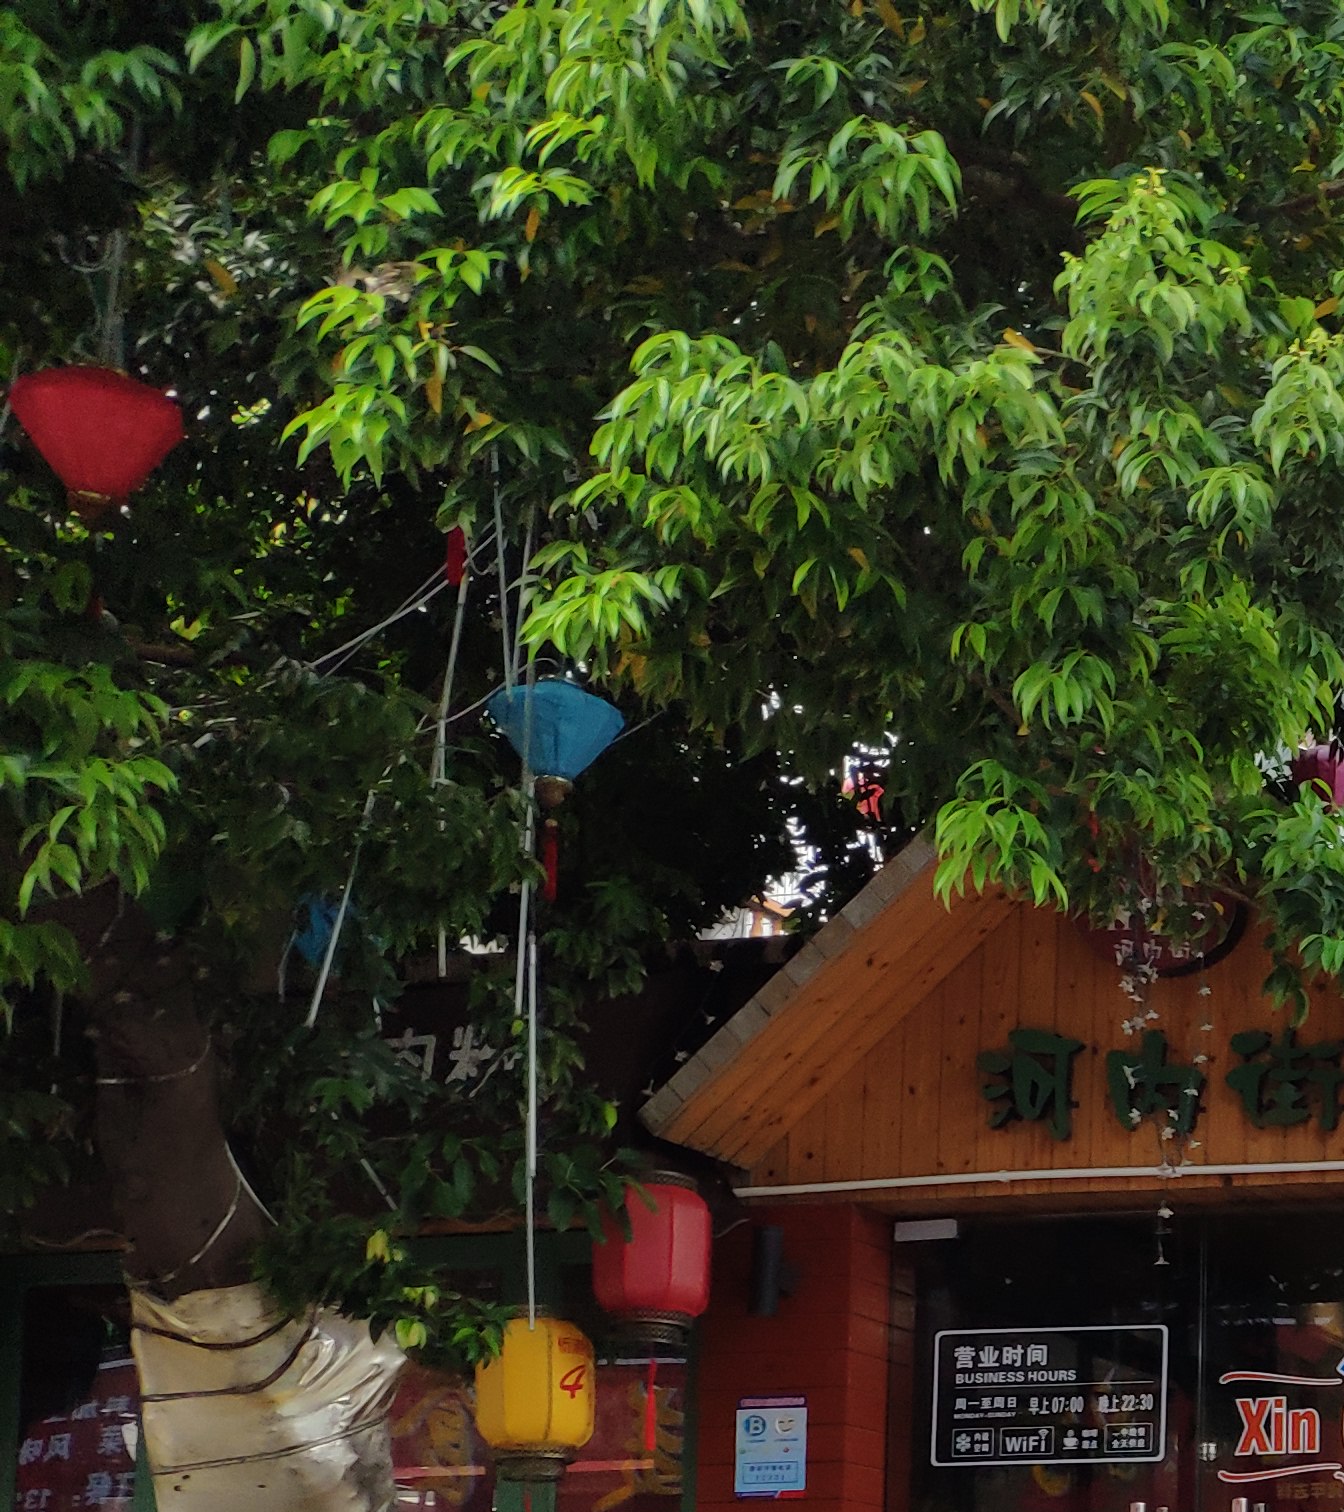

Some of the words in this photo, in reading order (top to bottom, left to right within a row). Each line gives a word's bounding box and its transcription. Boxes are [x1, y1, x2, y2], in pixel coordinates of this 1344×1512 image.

[954, 1344, 1048, 1369] 营业时间
[955, 1371, 1025, 1384] BUSINESS
[1027, 1369, 1077, 1382] HOURS
[954, 1396, 1017, 1410] 周一至周日
[1234, 1396, 1320, 1456] Xin
[1005, 1435, 1045, 1453] WiFi
